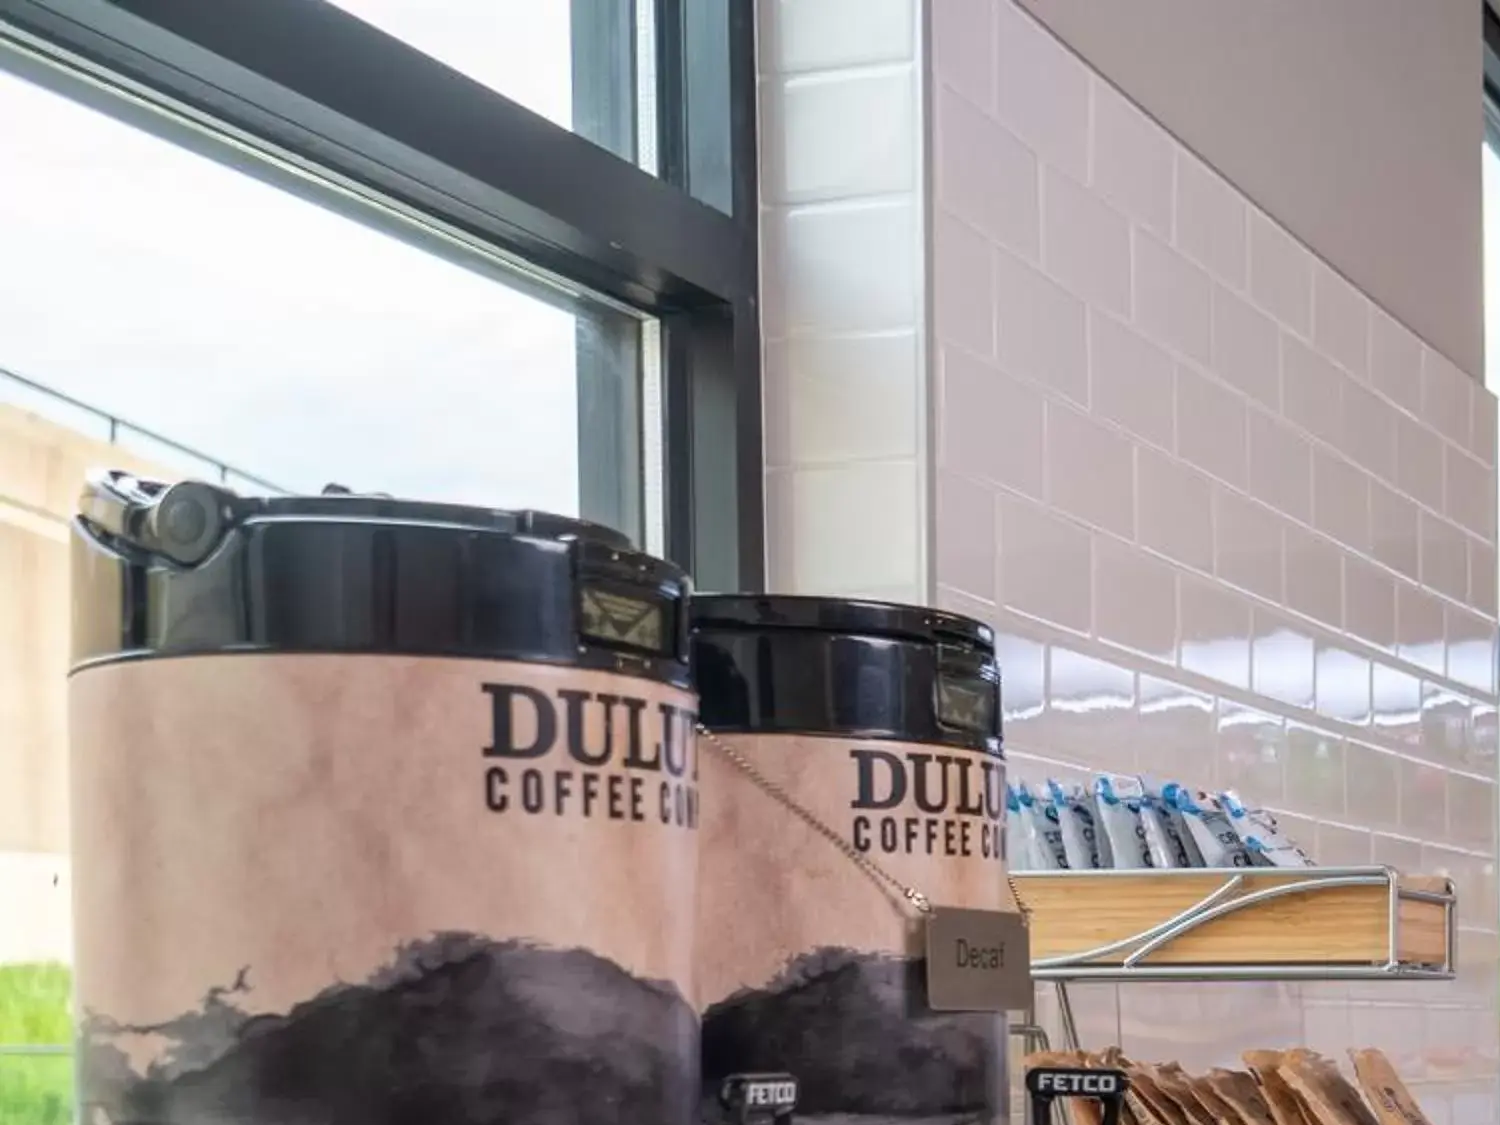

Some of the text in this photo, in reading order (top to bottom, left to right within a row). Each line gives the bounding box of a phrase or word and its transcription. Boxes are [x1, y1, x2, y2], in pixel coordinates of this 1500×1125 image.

[486, 767, 644, 821] COFFEE
[853, 817, 972, 857] COFFEE
[956, 938, 1005, 970] Decaf
[746, 1081, 796, 1105] FETCO
[1037, 1072, 1117, 1093] FETCO
